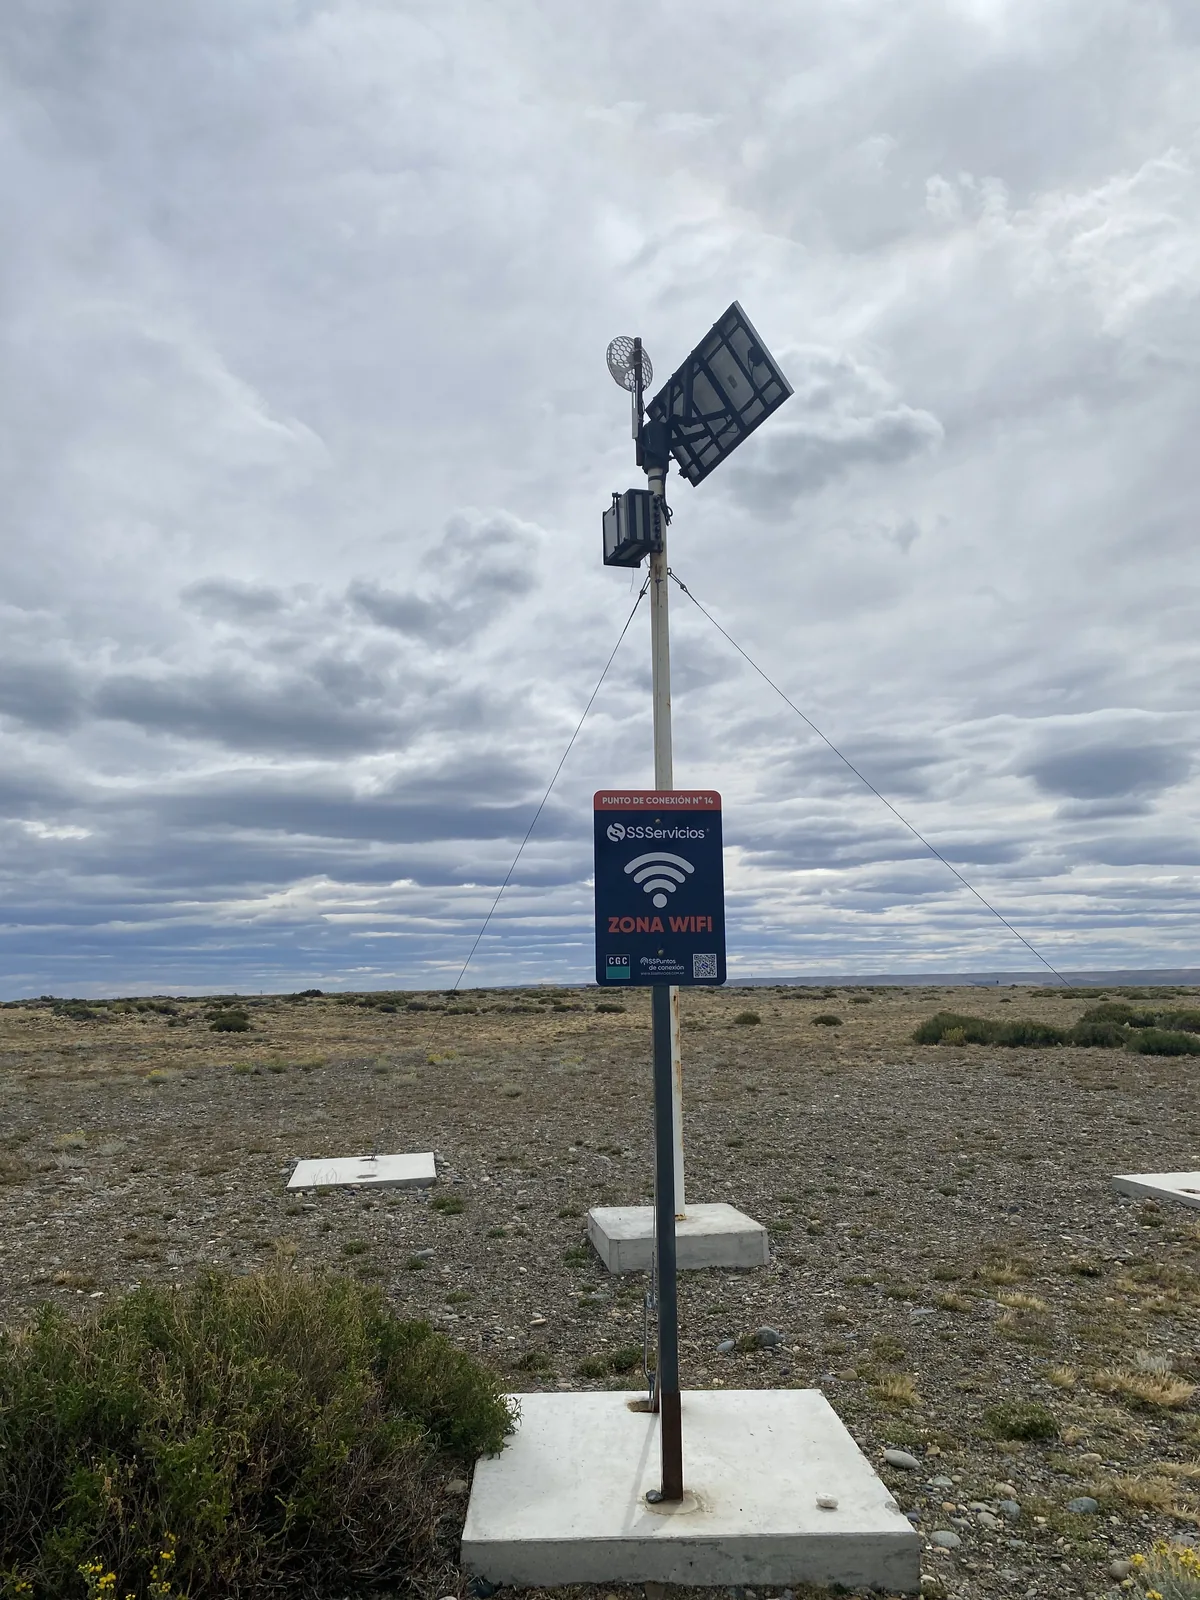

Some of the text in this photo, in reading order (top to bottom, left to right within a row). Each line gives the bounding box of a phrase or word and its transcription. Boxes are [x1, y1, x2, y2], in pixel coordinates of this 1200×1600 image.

[602, 796, 631, 804] PUNTO
[633, 796, 644, 804] DE
[646, 795, 690, 805] CONEXIÓN
[704, 796, 713, 804] 14
[626, 826, 705, 839] SSServicios
[608, 916, 712, 933] ZONA WIFI
[608, 956, 628, 965] CGC
